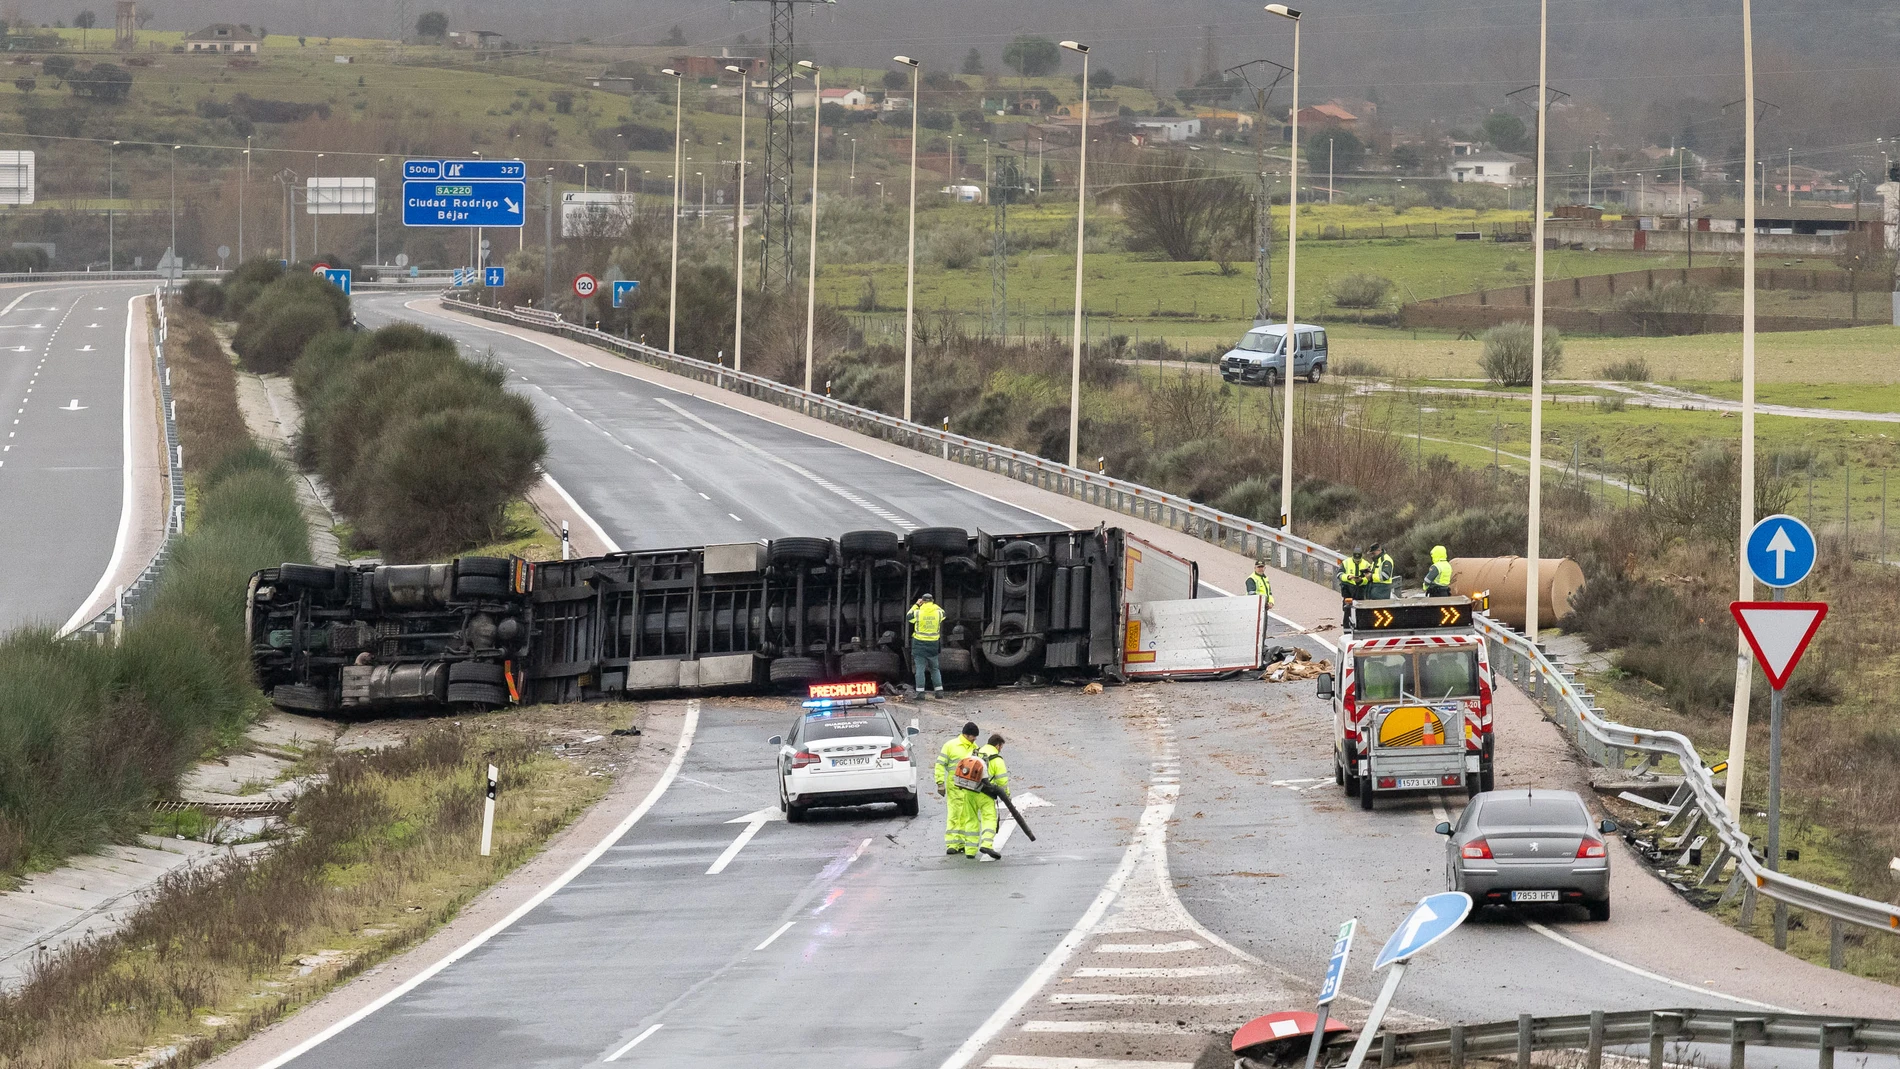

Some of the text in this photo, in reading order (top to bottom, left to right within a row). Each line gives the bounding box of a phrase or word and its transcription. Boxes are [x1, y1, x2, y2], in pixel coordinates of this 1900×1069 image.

[409, 166, 436, 174] 500m
[501, 166, 520, 174] 327
[437, 187, 471, 195] SA-220
[408, 198, 499, 210] Ciudad Rodrigo
[438, 210, 469, 222] Béjar
[577, 281, 593, 291] 120
[810, 682, 877, 698] PRECAUCION
[1402, 778, 1437, 787] 1573 LKK
[1516, 891, 1556, 900] 7853 HFV
